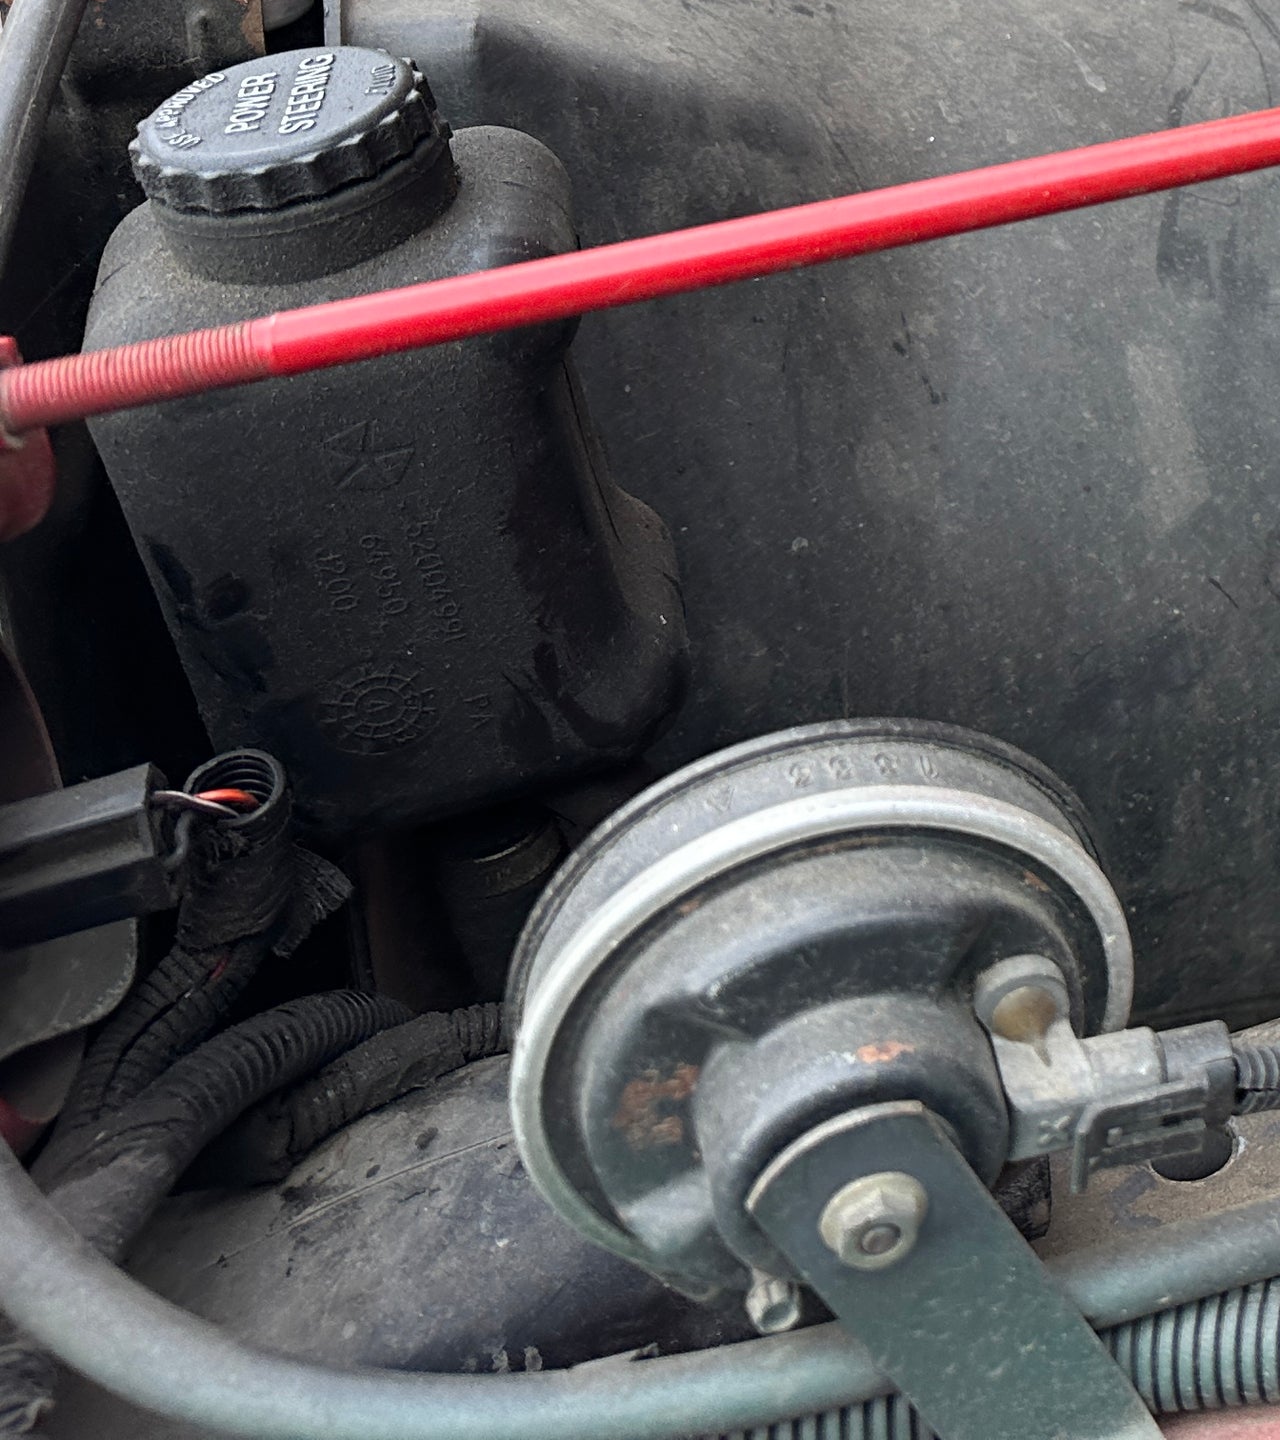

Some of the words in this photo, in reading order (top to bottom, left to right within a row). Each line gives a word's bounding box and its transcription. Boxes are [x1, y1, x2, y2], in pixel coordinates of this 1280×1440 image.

[154, 71, 227, 129] APPROVED
[224, 71, 279, 135] POWER
[278, 53, 336, 136] STEERING
